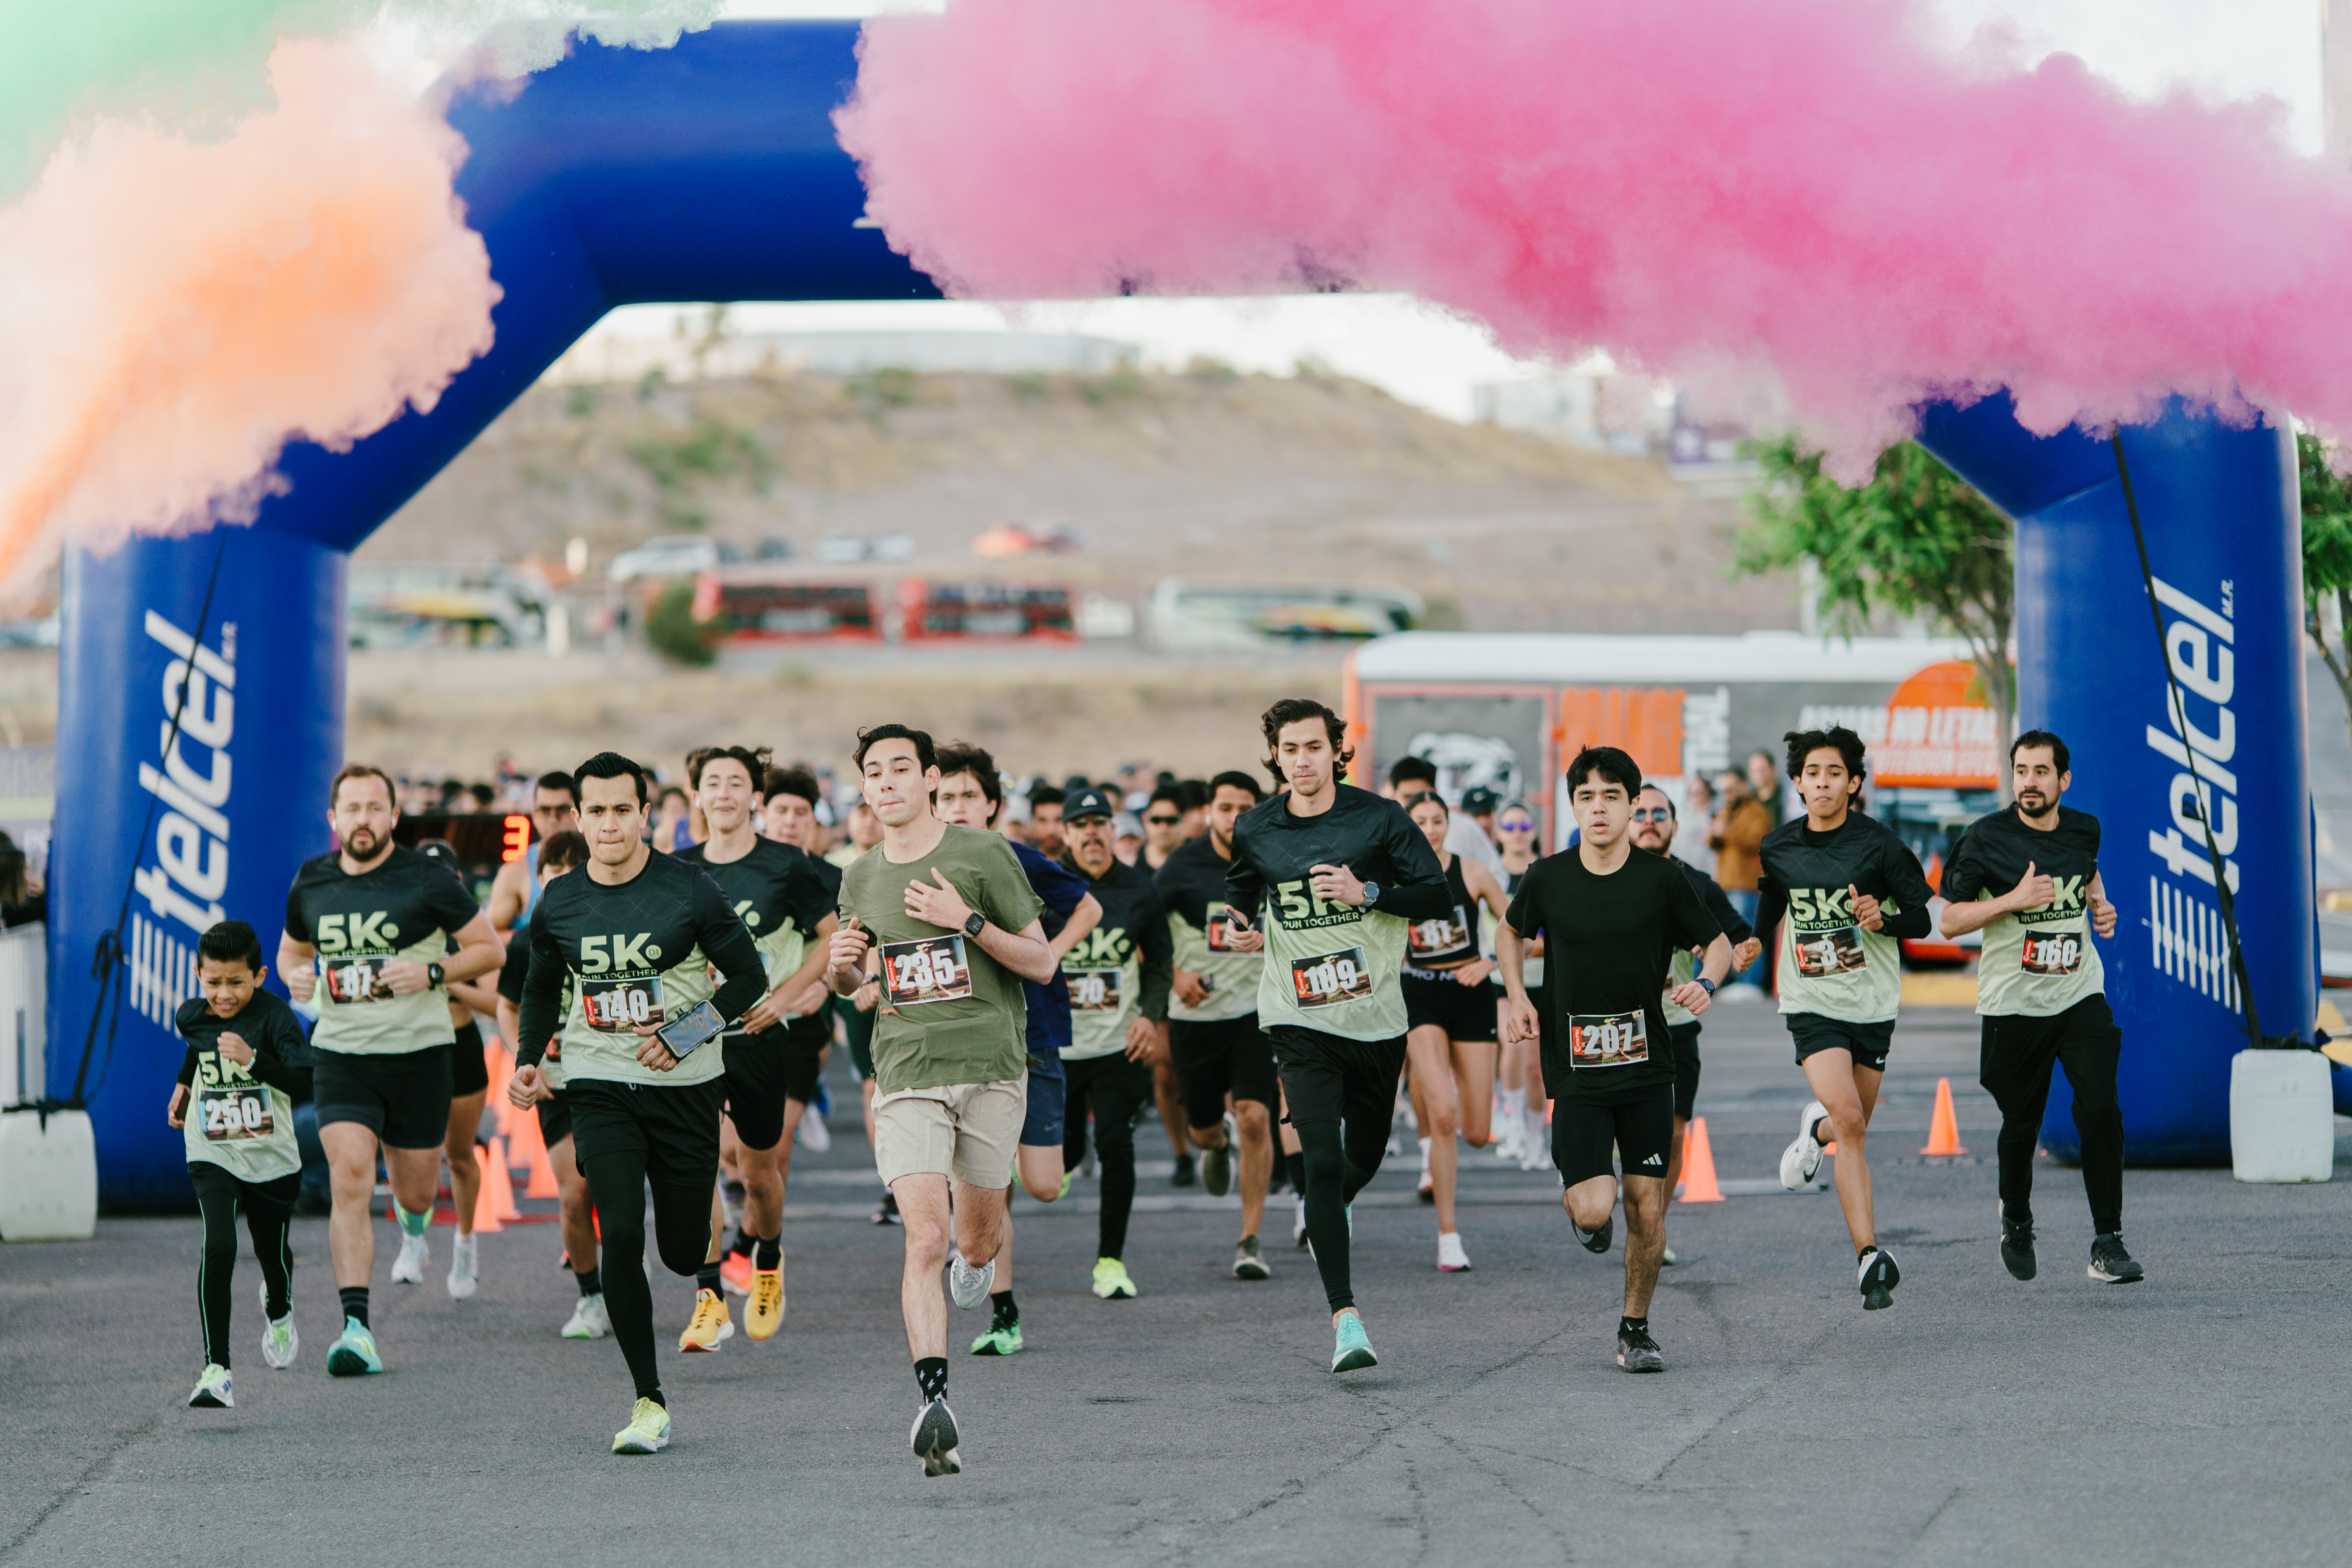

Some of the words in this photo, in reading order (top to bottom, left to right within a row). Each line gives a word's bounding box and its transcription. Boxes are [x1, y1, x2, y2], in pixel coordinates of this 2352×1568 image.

[2146, 575, 2240, 896] telcel
[134, 609, 236, 935] telcel
[502, 815, 531, 863] 3
[1283, 920, 1302, 929] RUN
[1303, 912, 1359, 927] TOGETHER
[1789, 888, 1849, 922] 5K
[2021, 913, 2040, 923] RUN
[318, 911, 389, 953] 5K
[1795, 920, 1808, 929] RUN
[581, 933, 653, 974] 5K
[649, 948, 659, 957] D1
[895, 948, 956, 990] 235
[1819, 939, 1838, 967] 3
[2034, 939, 2078, 967] 160
[342, 964, 372, 997] 87
[603, 969, 657, 980] TOGETHER
[1075, 976, 1105, 1005] 70
[1304, 959, 1358, 996] 109
[594, 989, 649, 1023] 140
[1584, 1022, 1633, 1055] 207
[198, 1051, 254, 1084] 5K
[205, 1096, 262, 1131] 250
